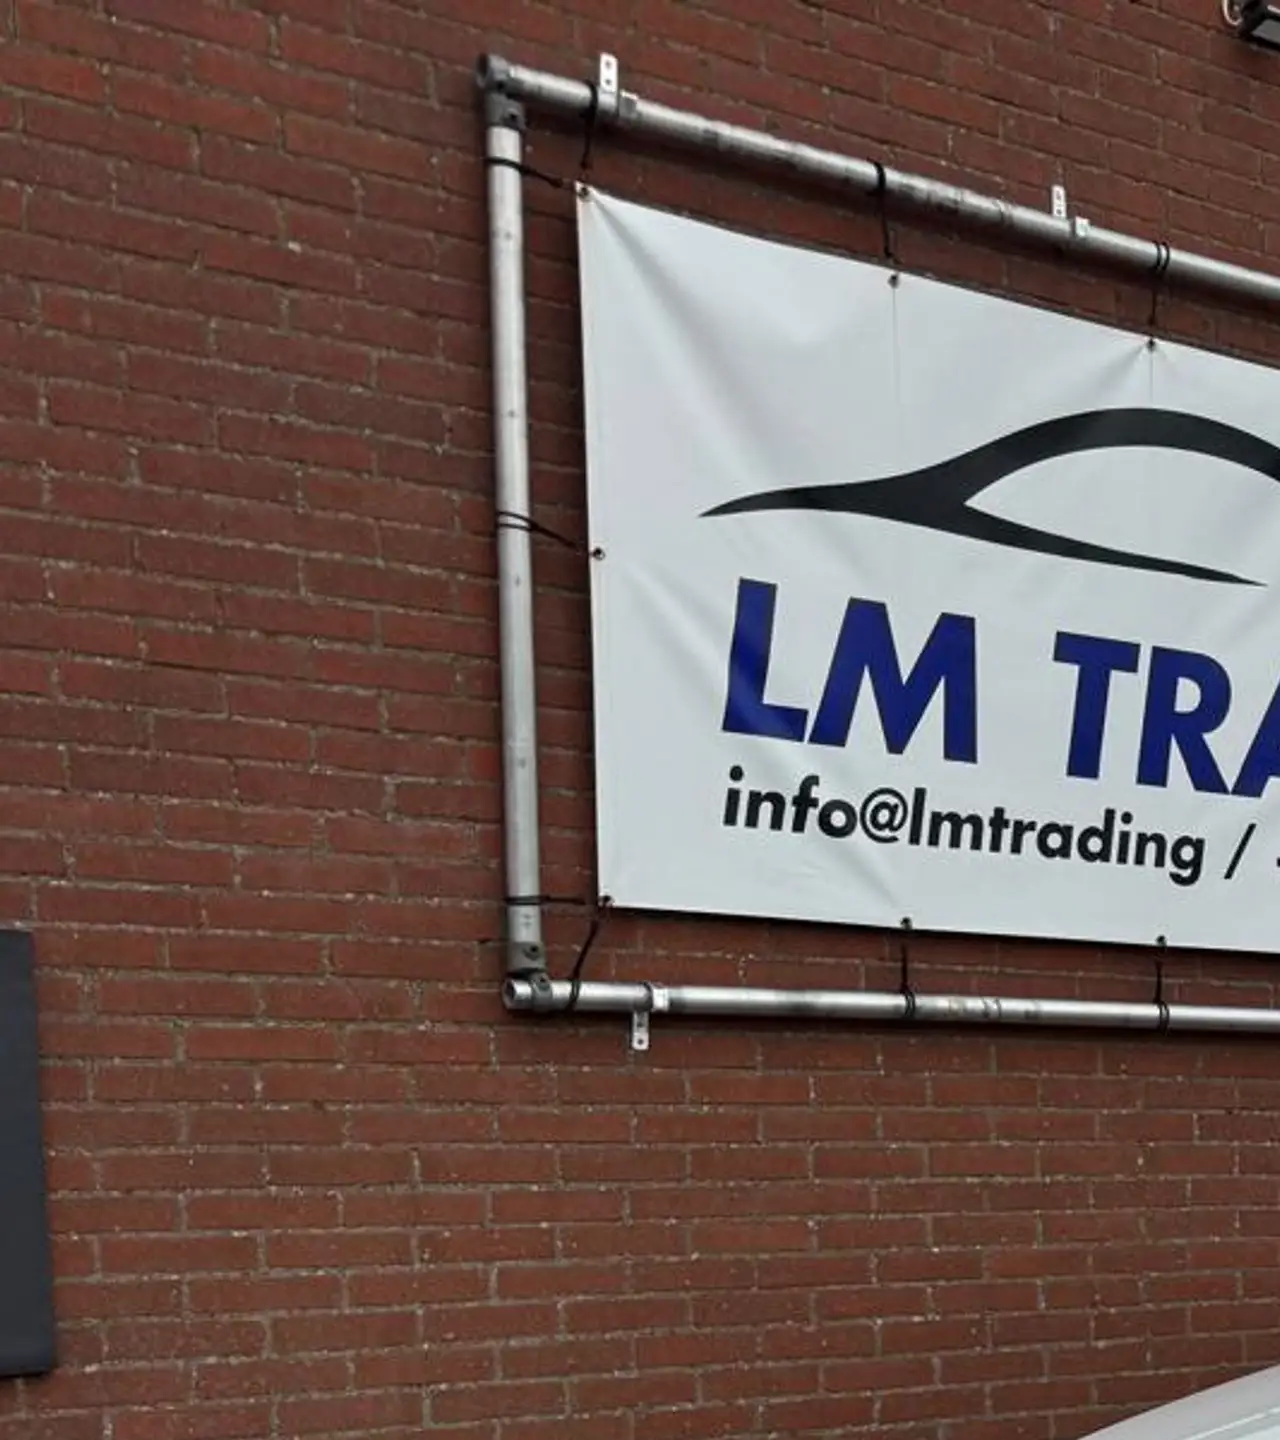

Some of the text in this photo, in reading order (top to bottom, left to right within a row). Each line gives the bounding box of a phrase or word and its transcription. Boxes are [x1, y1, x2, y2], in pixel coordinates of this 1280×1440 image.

[722, 580, 977, 763] LM
[722, 766, 1204, 886] info@lmtrading
[1224, 824, 1256, 880] /
